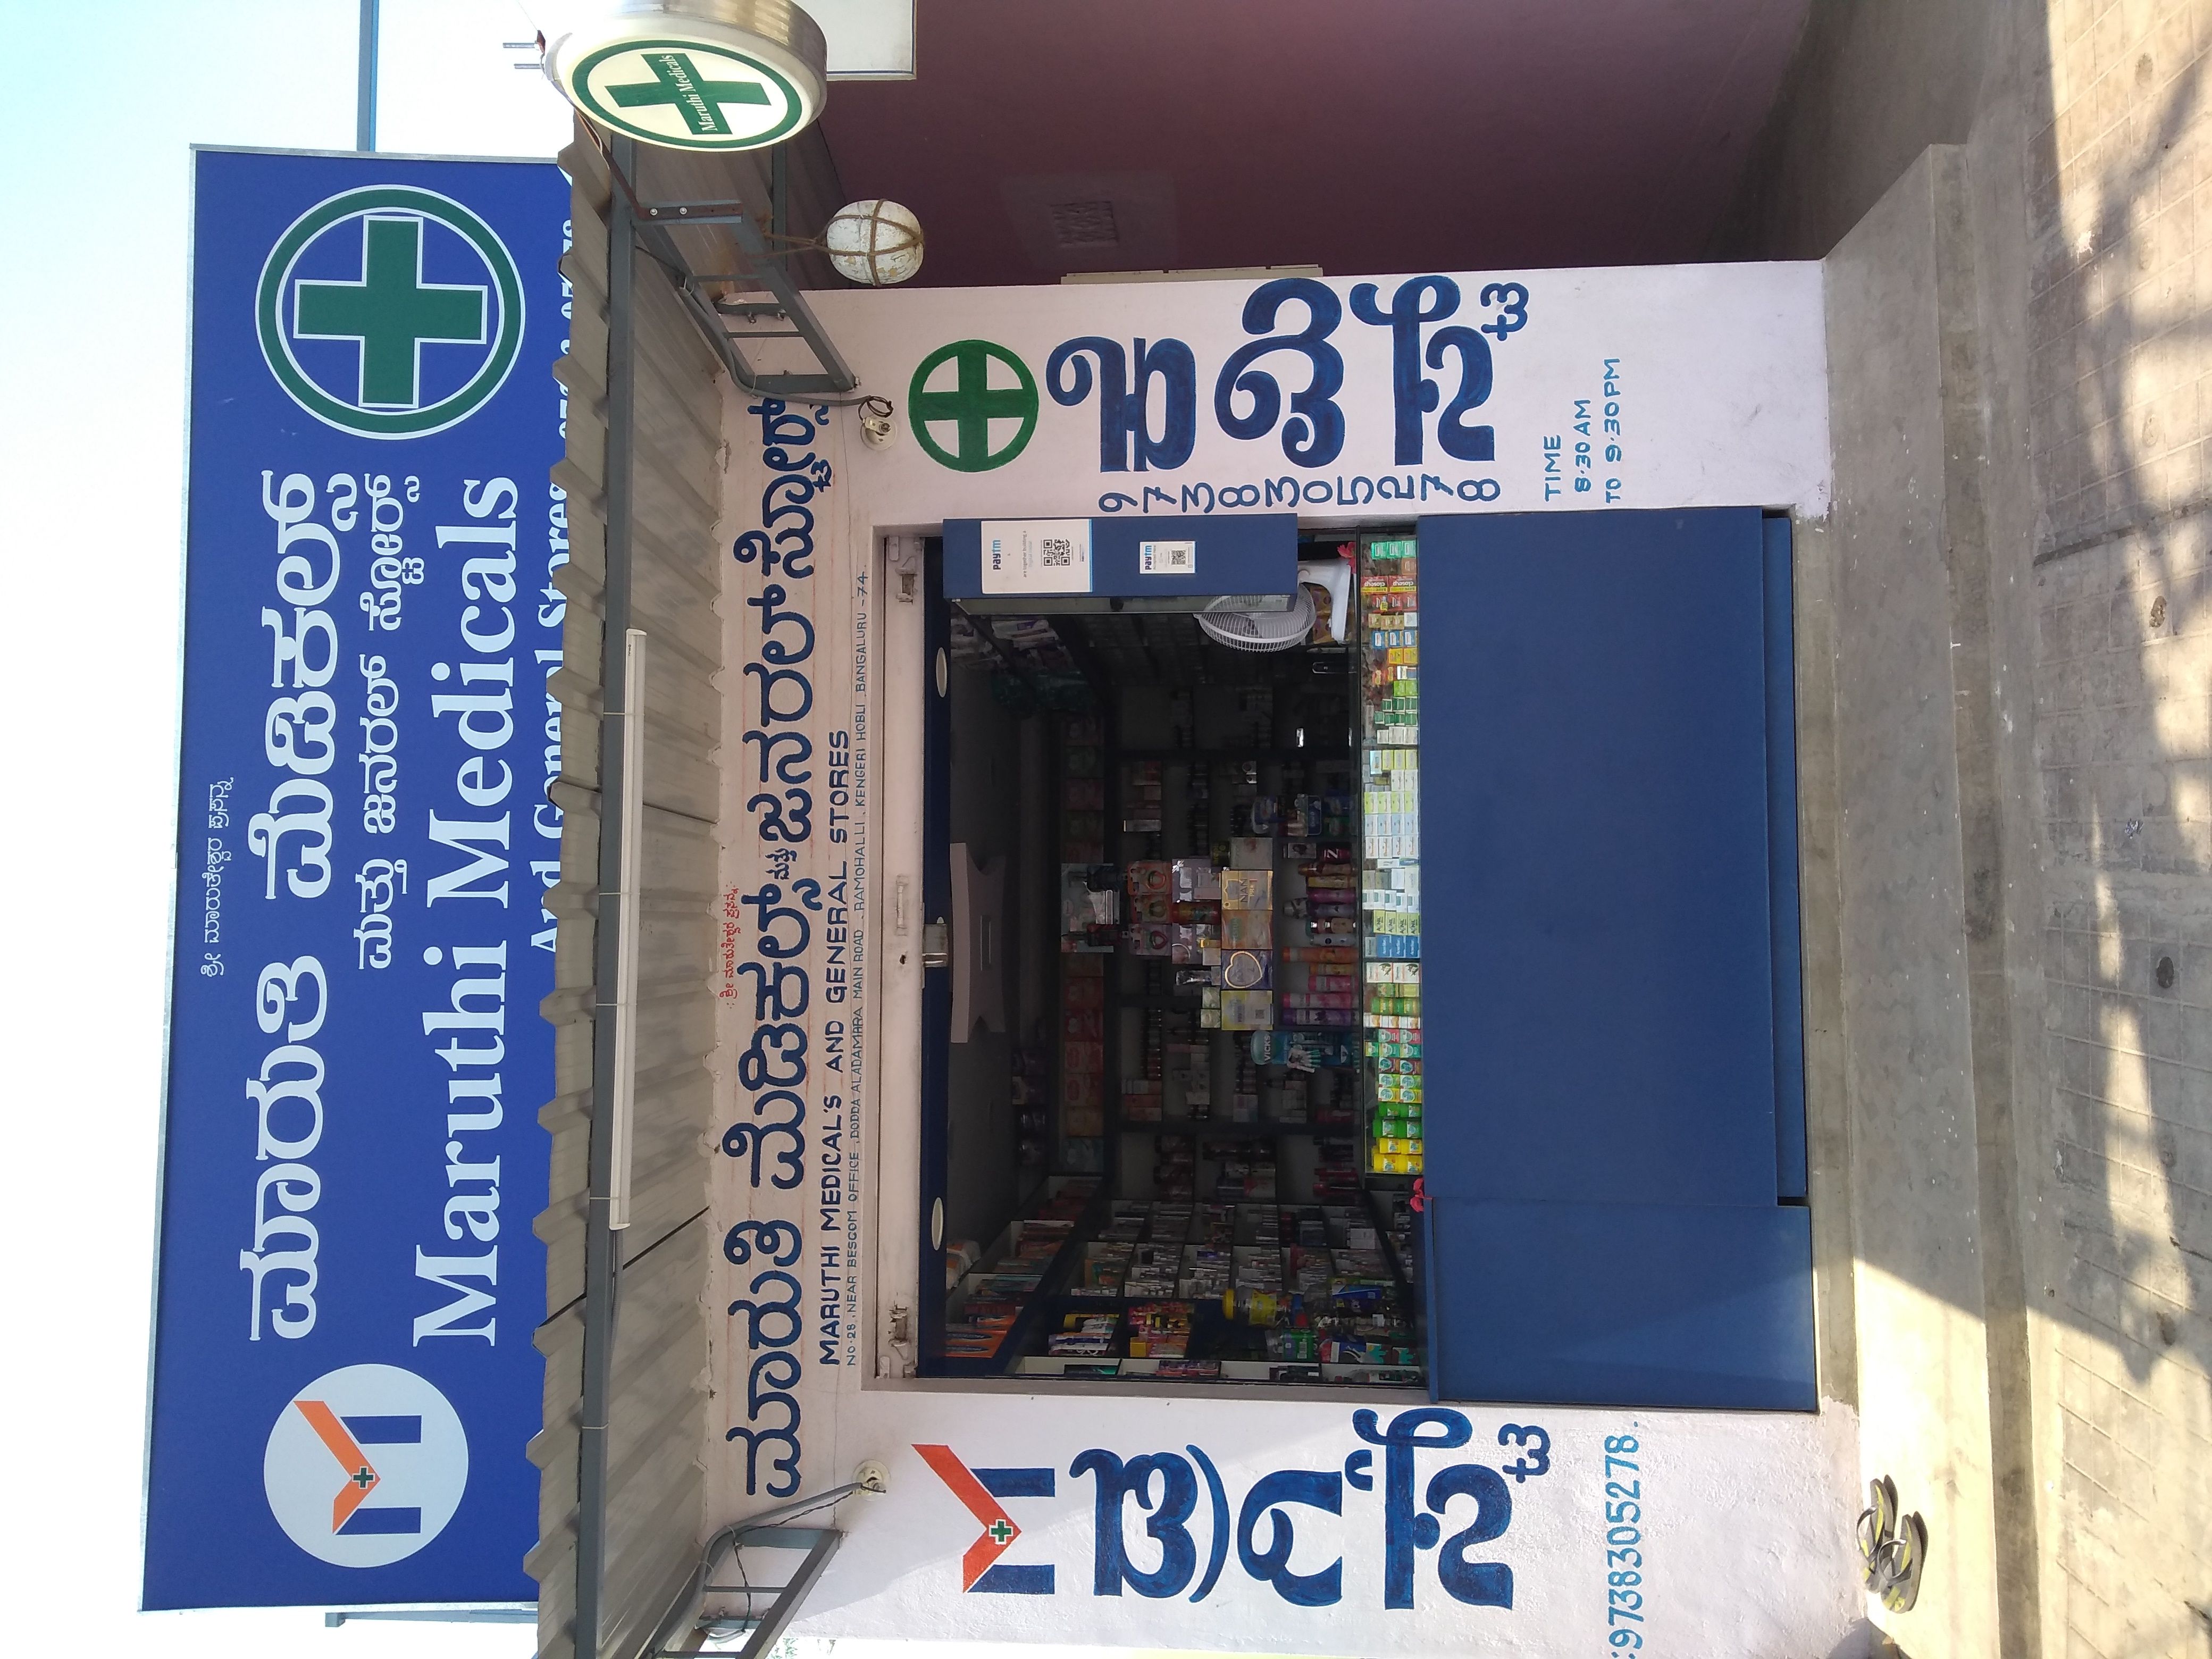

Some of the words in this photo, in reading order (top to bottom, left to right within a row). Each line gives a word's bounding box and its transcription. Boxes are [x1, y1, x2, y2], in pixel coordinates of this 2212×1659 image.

[659, 54, 696, 92] Medicals
[684, 94, 718, 131] Maruthi
[1543, 434, 1561, 502] TIME
[1605, 477, 1622, 504] TO
[359, 473, 424, 631] ಸ್ಟೋರ್ಸ್
[247, 470, 358, 900] ಮೆಡಿಕಲ್ಸ್
[426, 475, 518, 908] Medicals
[741, 584, 815, 843] ಜನರಲ್
[855, 704, 866, 741] HOBLI
[358, 653, 399, 834] ಜನರಲ್
[828, 730, 850, 844] STORES
[855, 748, 867, 807] KENGERI
[353, 859, 408, 969] ಮತ್ತು
[529, 861, 561, 953] Ad
[765, 848, 798, 880] ಮತ್ತು
[825, 860, 848, 1003] GENERAL
[852, 929, 864, 962] ROAD
[852, 967, 864, 999] MAIN
[721, 877, 823, 1189] ಮೆಡಿಕಲ್ಸ್
[824, 1020, 844, 1073] AND
[239, 955, 328, 1340] ಮಾರುತಿ
[412, 939, 509, 1347] Maruthi
[819, 1095, 842, 1231] MEDICAL'S
[848, 1152, 859, 1202] OFFICE
[847, 1210, 858, 1268] BESCOM
[723, 1219, 803, 1498] ಮಾರುತಿ
[818, 1246, 841, 1366] MARUTHI
